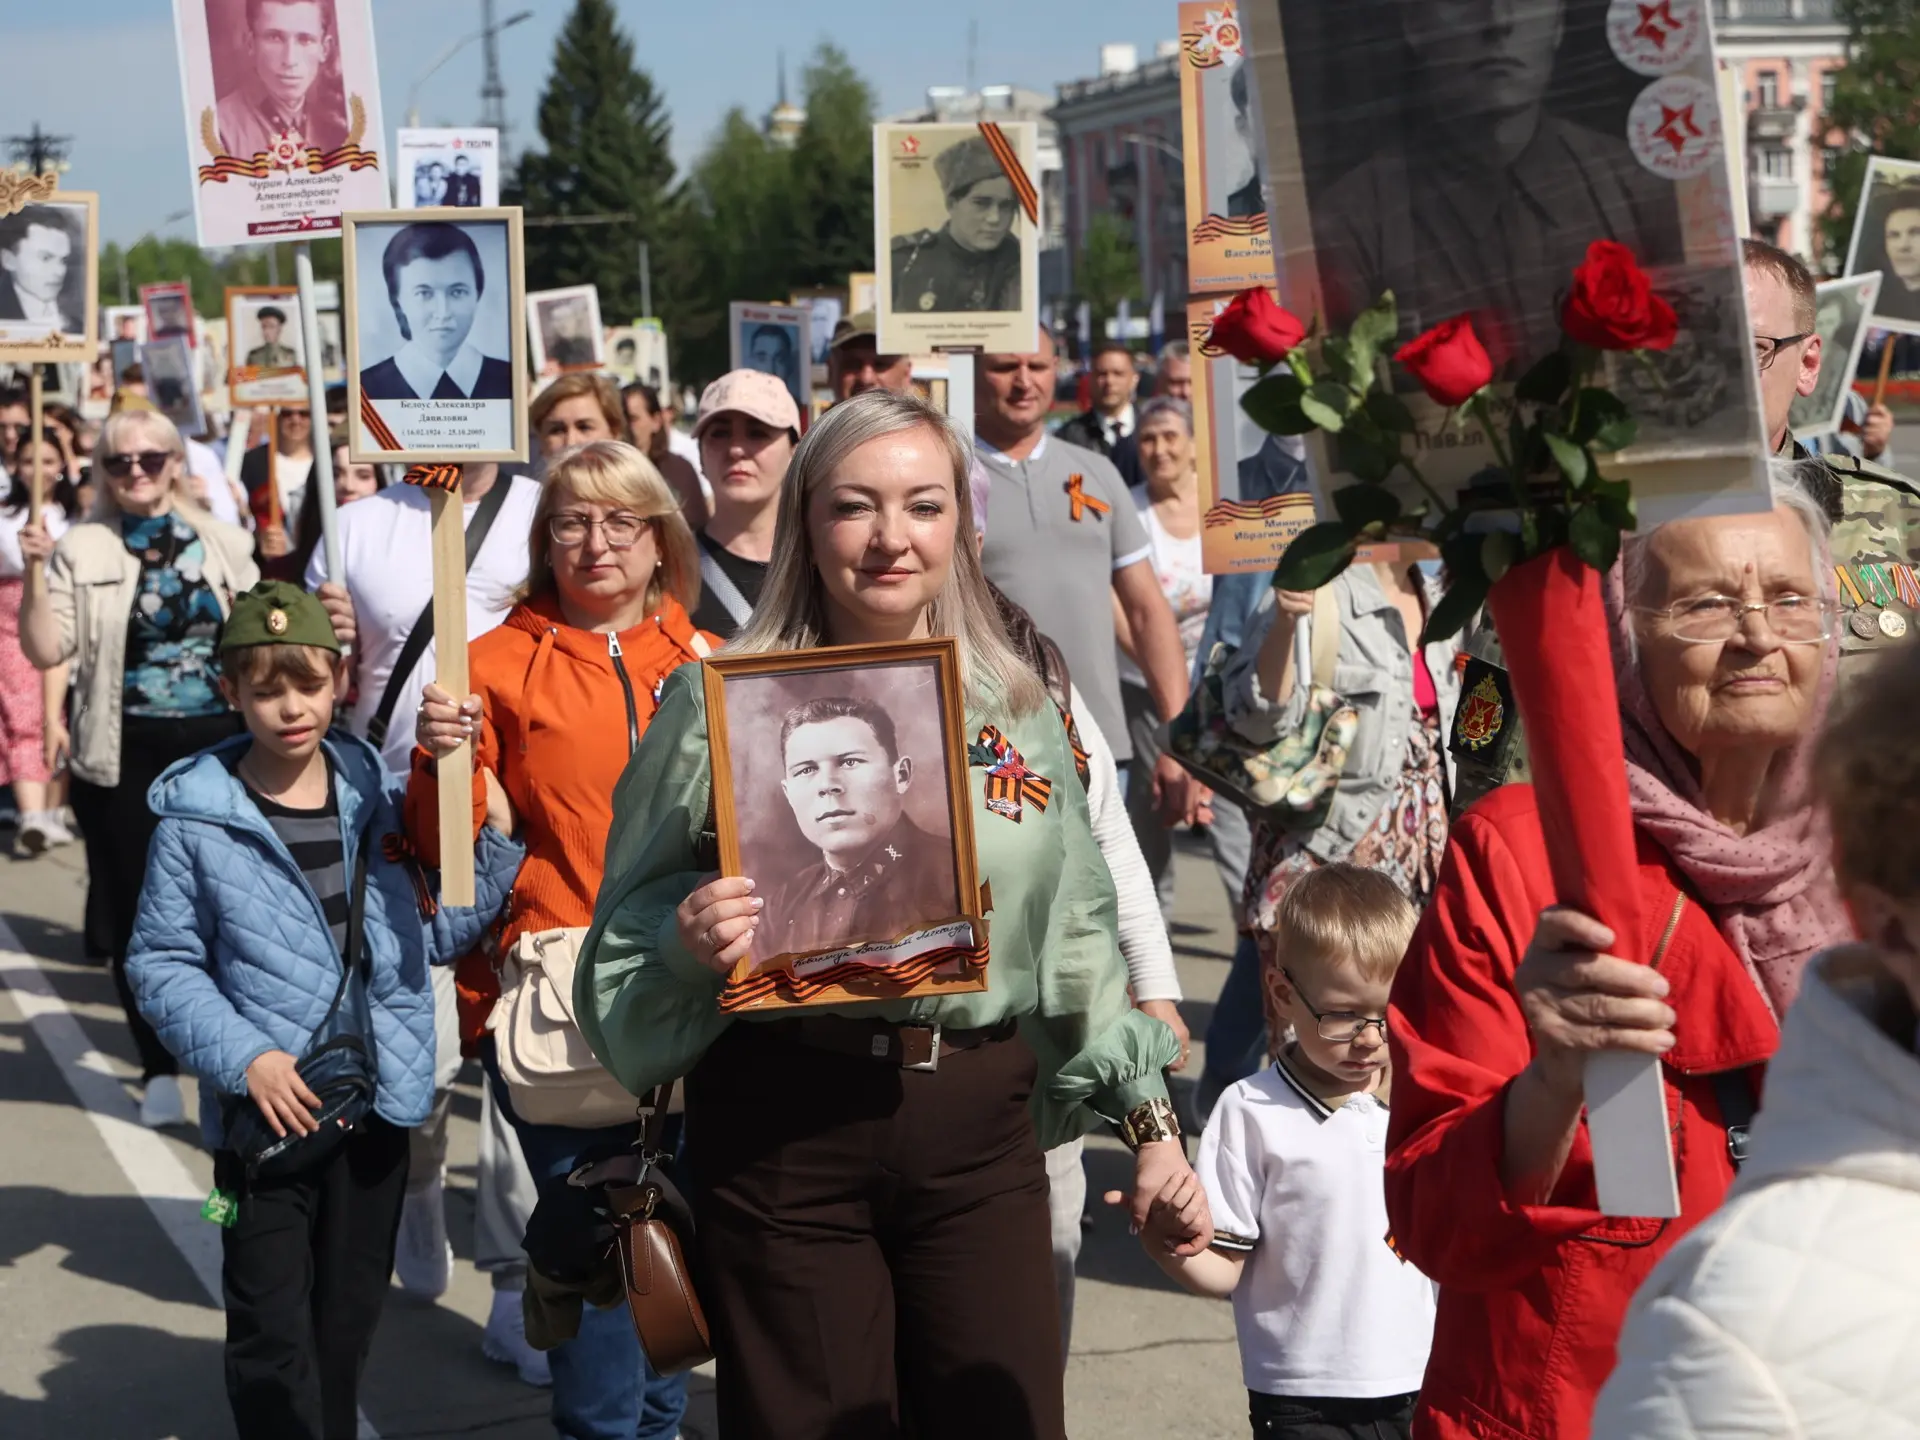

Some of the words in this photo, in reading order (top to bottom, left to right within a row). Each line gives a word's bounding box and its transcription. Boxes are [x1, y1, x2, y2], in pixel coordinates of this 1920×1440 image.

[285, 173, 344, 187] Александр
[255, 187, 341, 202] Александрович
[400, 400, 431, 411] Белоус
[433, 400, 487, 411] Александра
[418, 413, 468, 424] Даниловна
[855, 938, 913, 955] Василий
